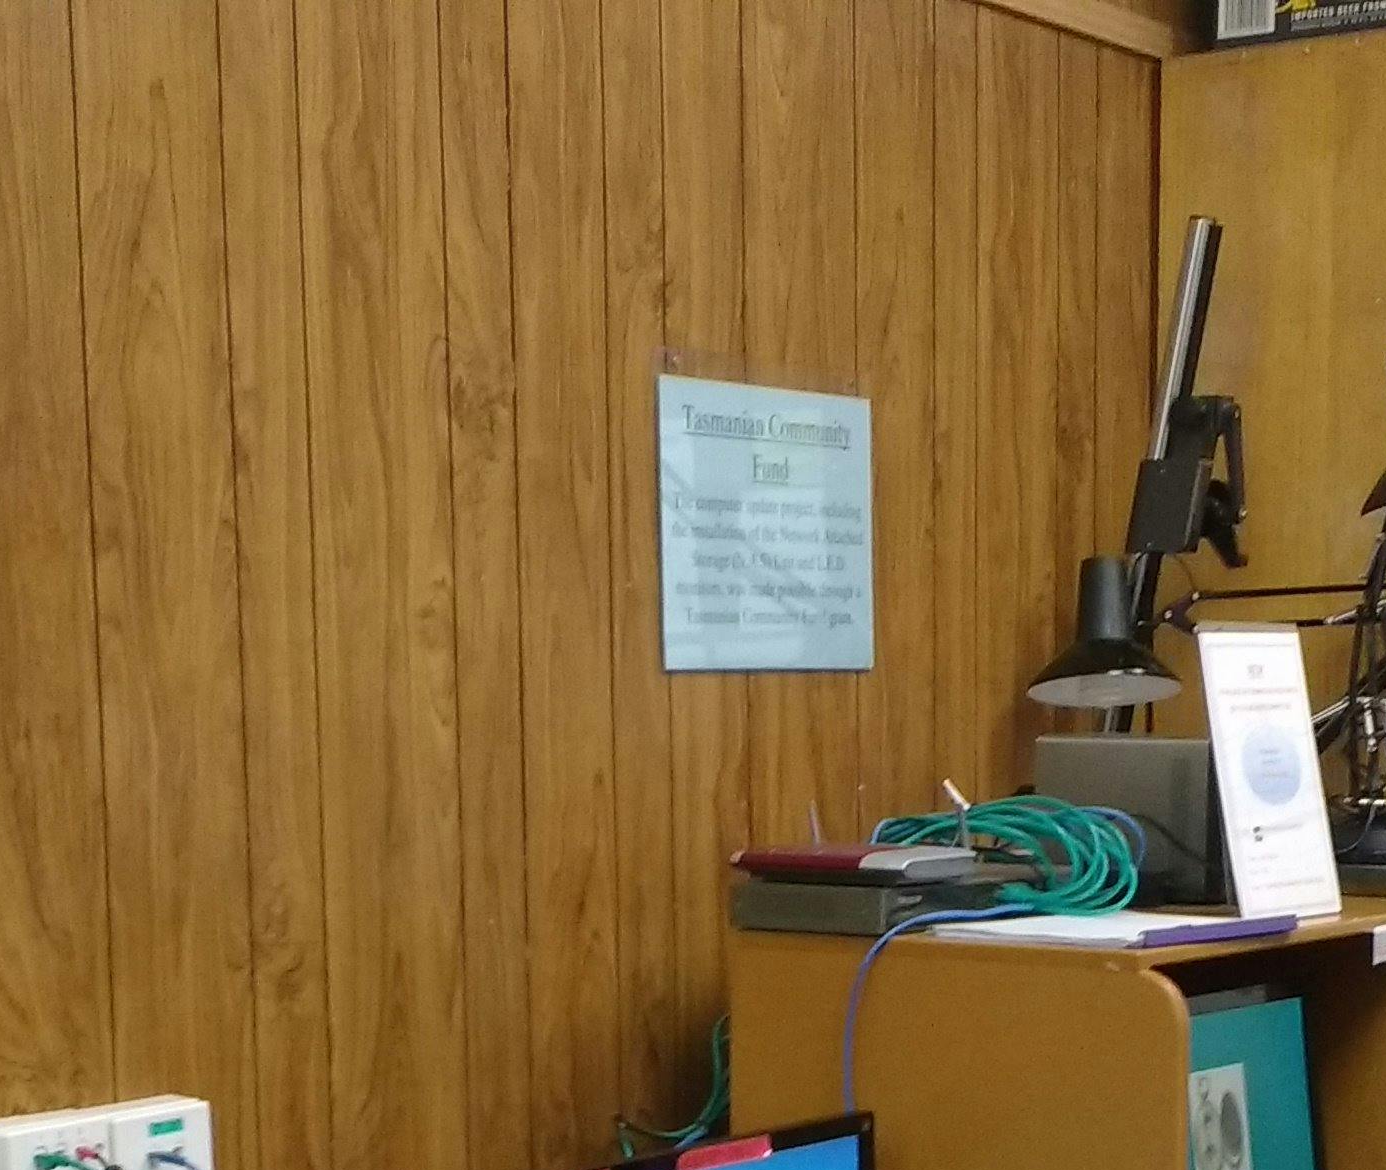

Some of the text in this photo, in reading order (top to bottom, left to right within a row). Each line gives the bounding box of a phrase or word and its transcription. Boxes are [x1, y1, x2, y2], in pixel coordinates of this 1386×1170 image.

[681, 403, 853, 448] Tasmanian Community
[753, 452, 789, 481] Fund
